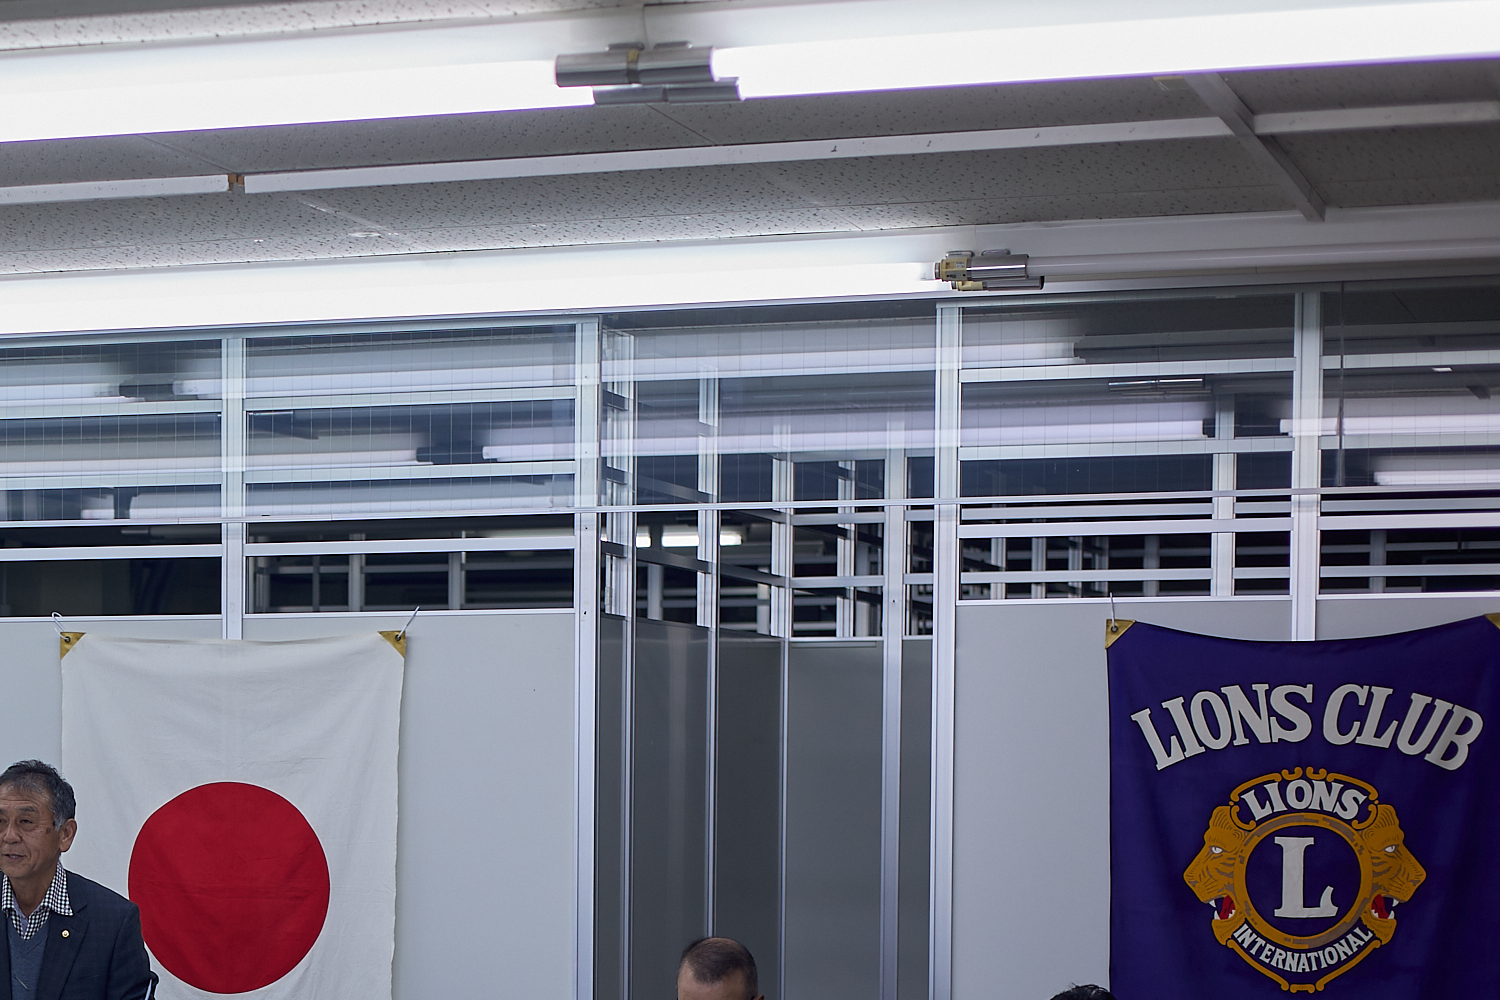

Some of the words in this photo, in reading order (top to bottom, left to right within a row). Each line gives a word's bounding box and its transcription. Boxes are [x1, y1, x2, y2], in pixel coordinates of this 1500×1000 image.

[1131, 683, 1314, 771] LIONS
[1322, 683, 1483, 771] CLUB
[1240, 779, 1367, 821] LIONS
[1273, 836, 1338, 918] L
[1232, 923, 1373, 974] INTERNATIONAL
